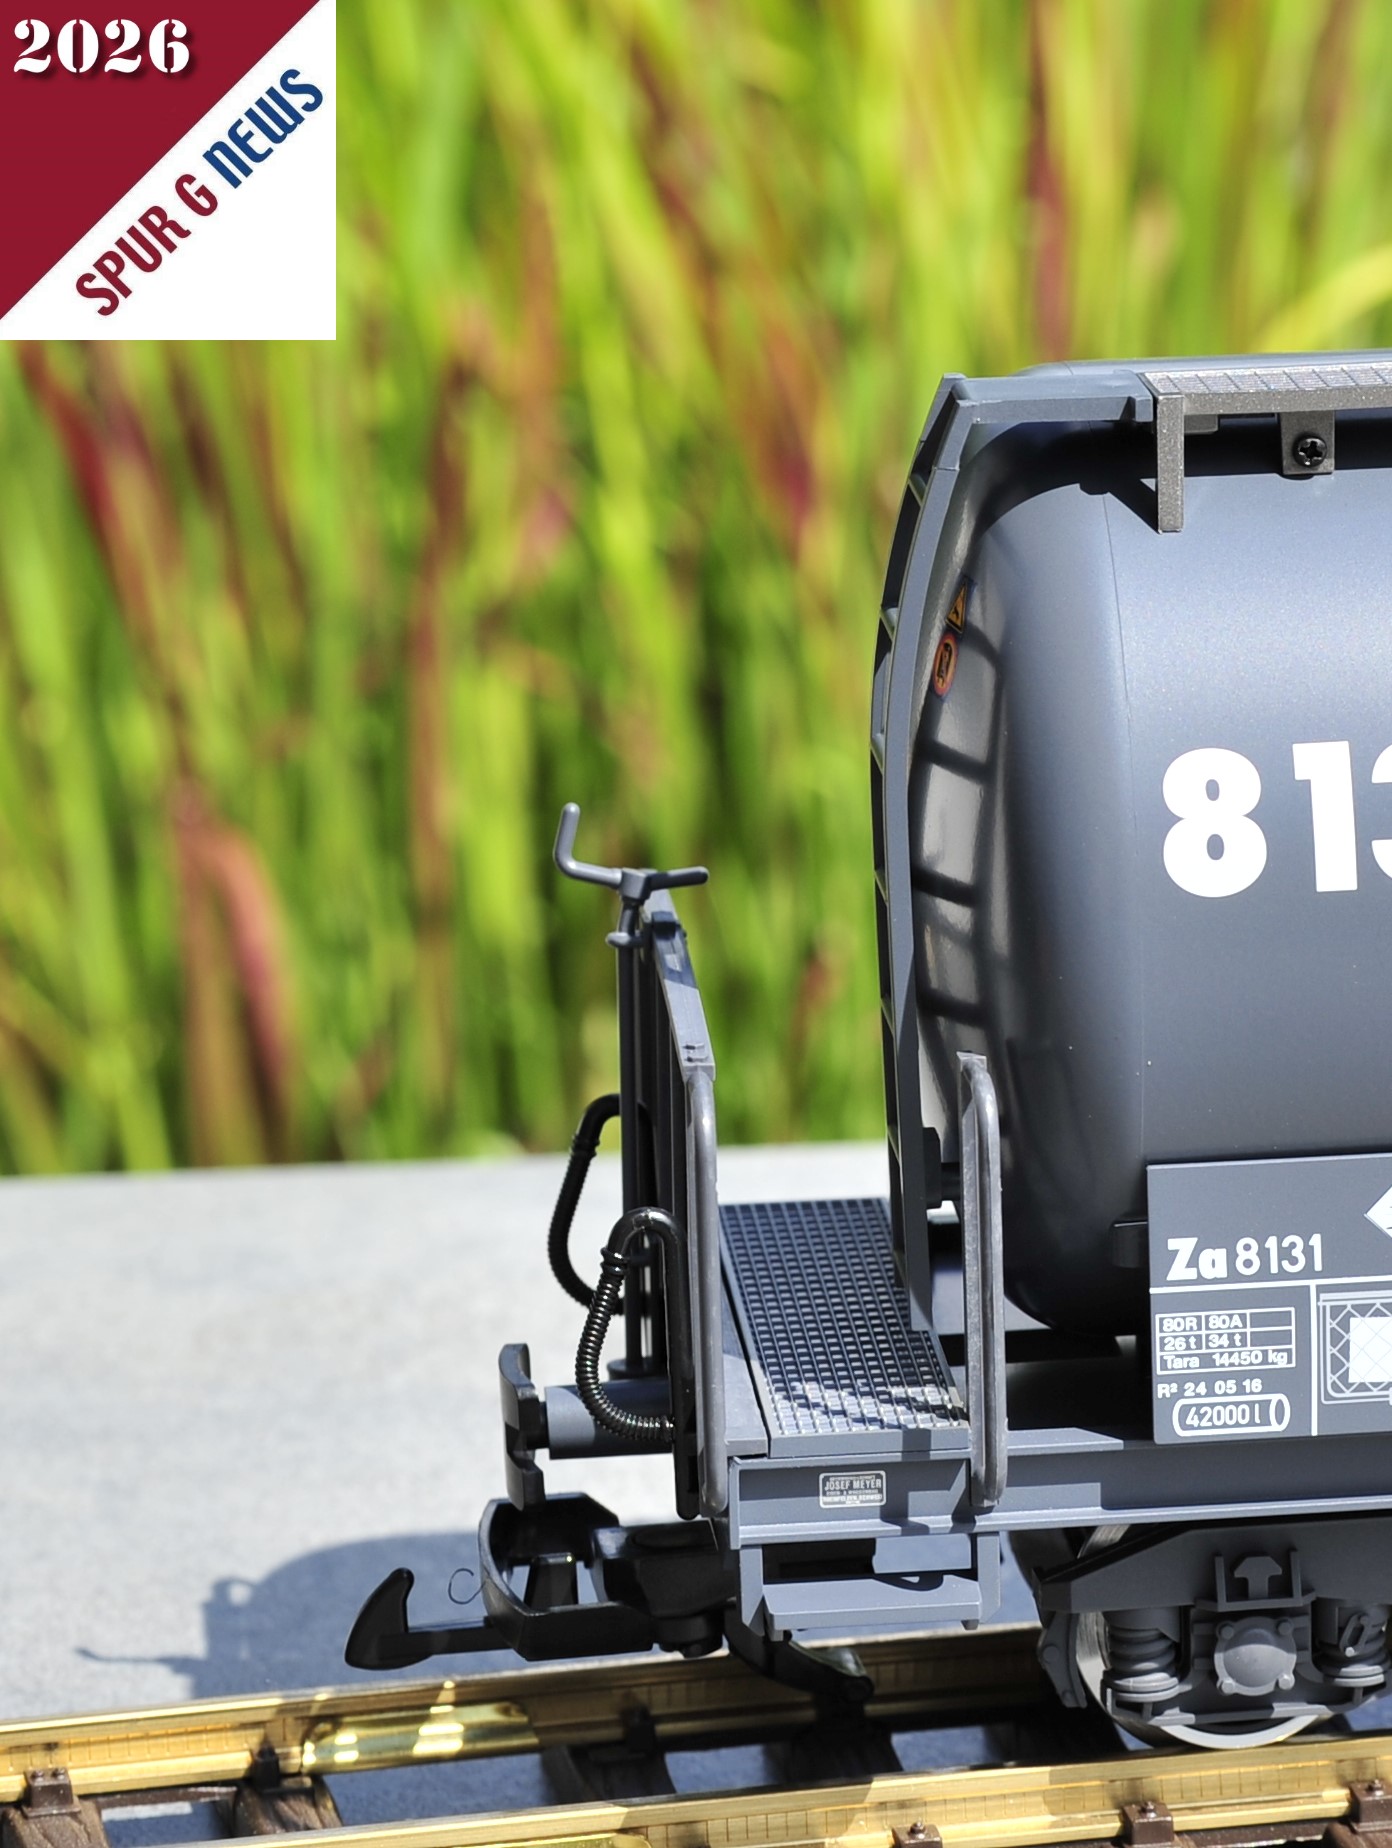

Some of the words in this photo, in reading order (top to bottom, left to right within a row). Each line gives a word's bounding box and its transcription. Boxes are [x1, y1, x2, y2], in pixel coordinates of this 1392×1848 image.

[1166, 1237, 1228, 1281] Za
[1235, 1233, 1323, 1276] 8131
[1162, 1316, 1198, 1332] 80R
[1208, 1314, 1244, 1329] 80A
[1163, 1337, 1187, 1351] 26
[1188, 1335, 1197, 1349] t
[1208, 1334, 1230, 1348] 34
[1233, 1333, 1242, 1347] t
[1163, 1354, 1200, 1369] Tara
[1212, 1350, 1263, 1367] 14450
[1267, 1349, 1289, 1366] kg
[1183, 1382, 1207, 1397] 24
[1214, 1379, 1237, 1394] 05
[1242, 1378, 1263, 1393] 16
[1185, 1403, 1250, 1427] 42000
[824, 1480, 851, 1491] JOSEF
[853, 1478, 882, 1489] MEYER
